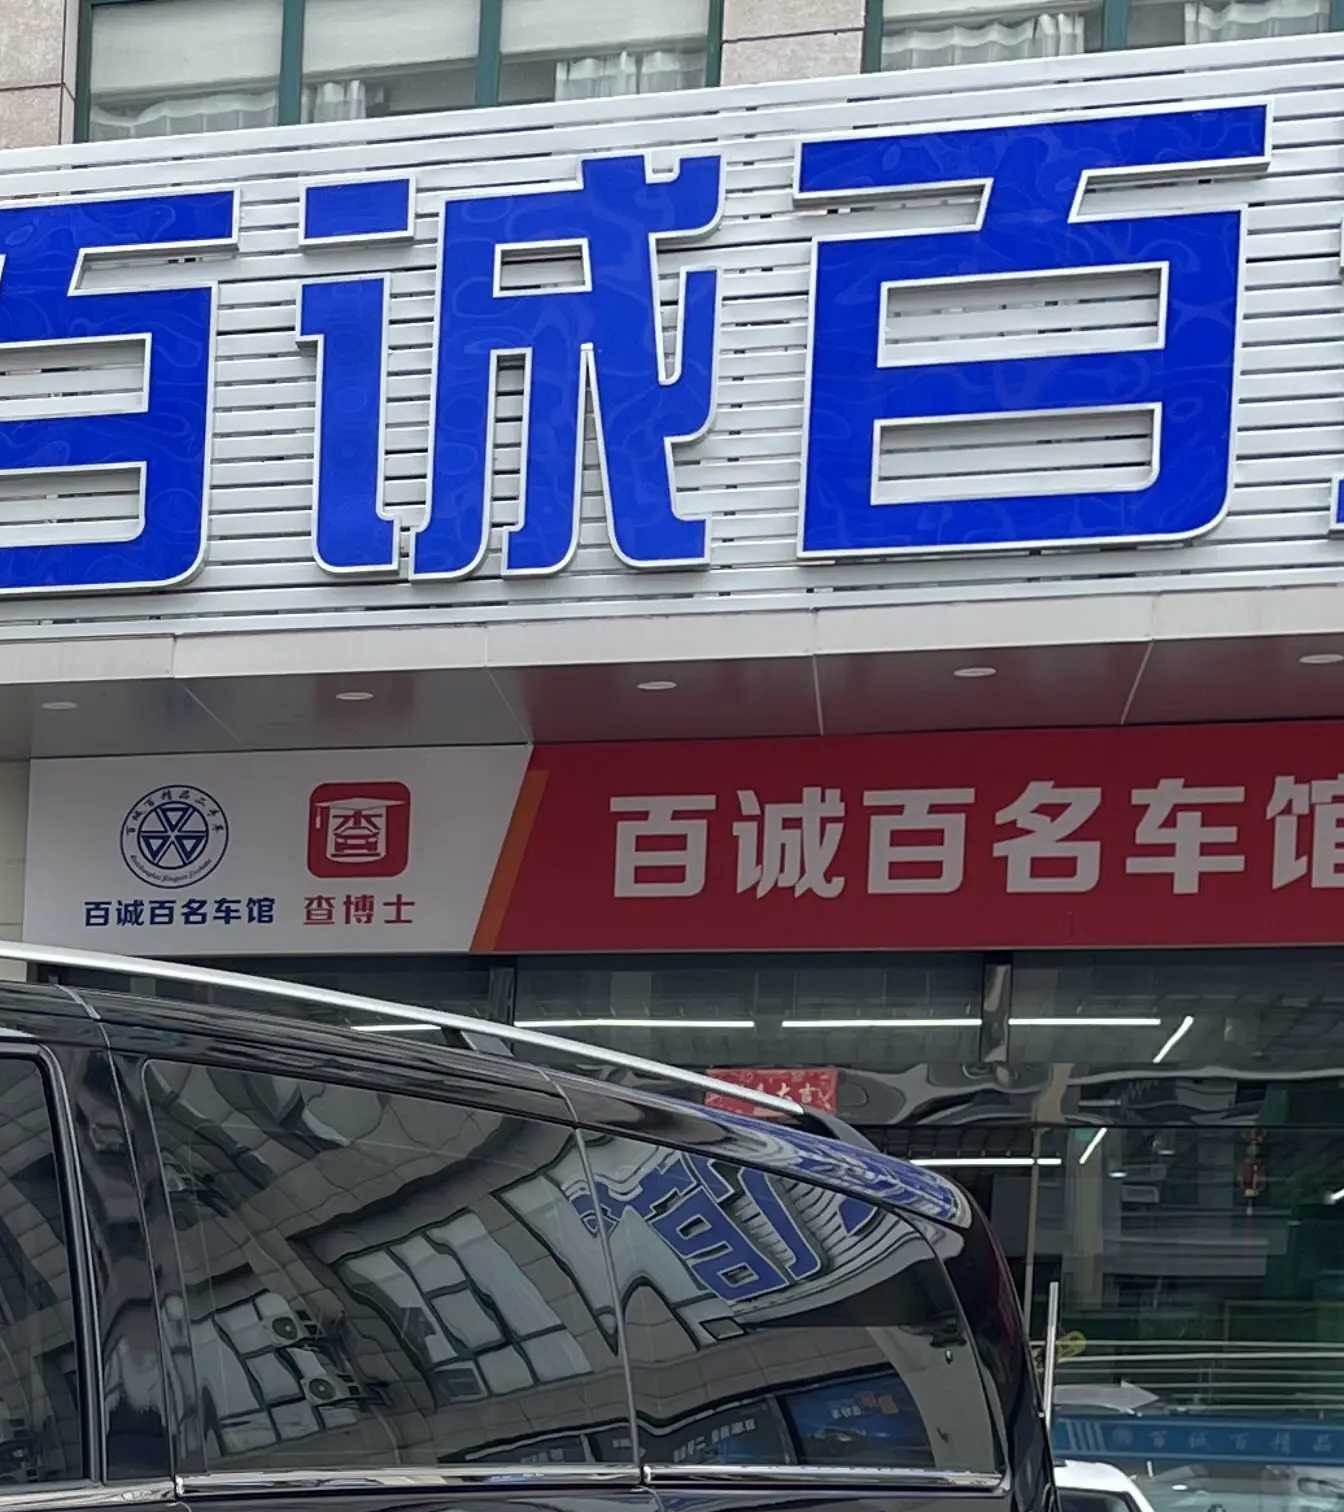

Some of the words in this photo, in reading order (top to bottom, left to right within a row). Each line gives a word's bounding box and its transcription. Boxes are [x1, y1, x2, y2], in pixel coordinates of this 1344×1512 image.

[83, 897, 276, 927] 百诚百名车馆
[303, 894, 416, 926] 查博士
